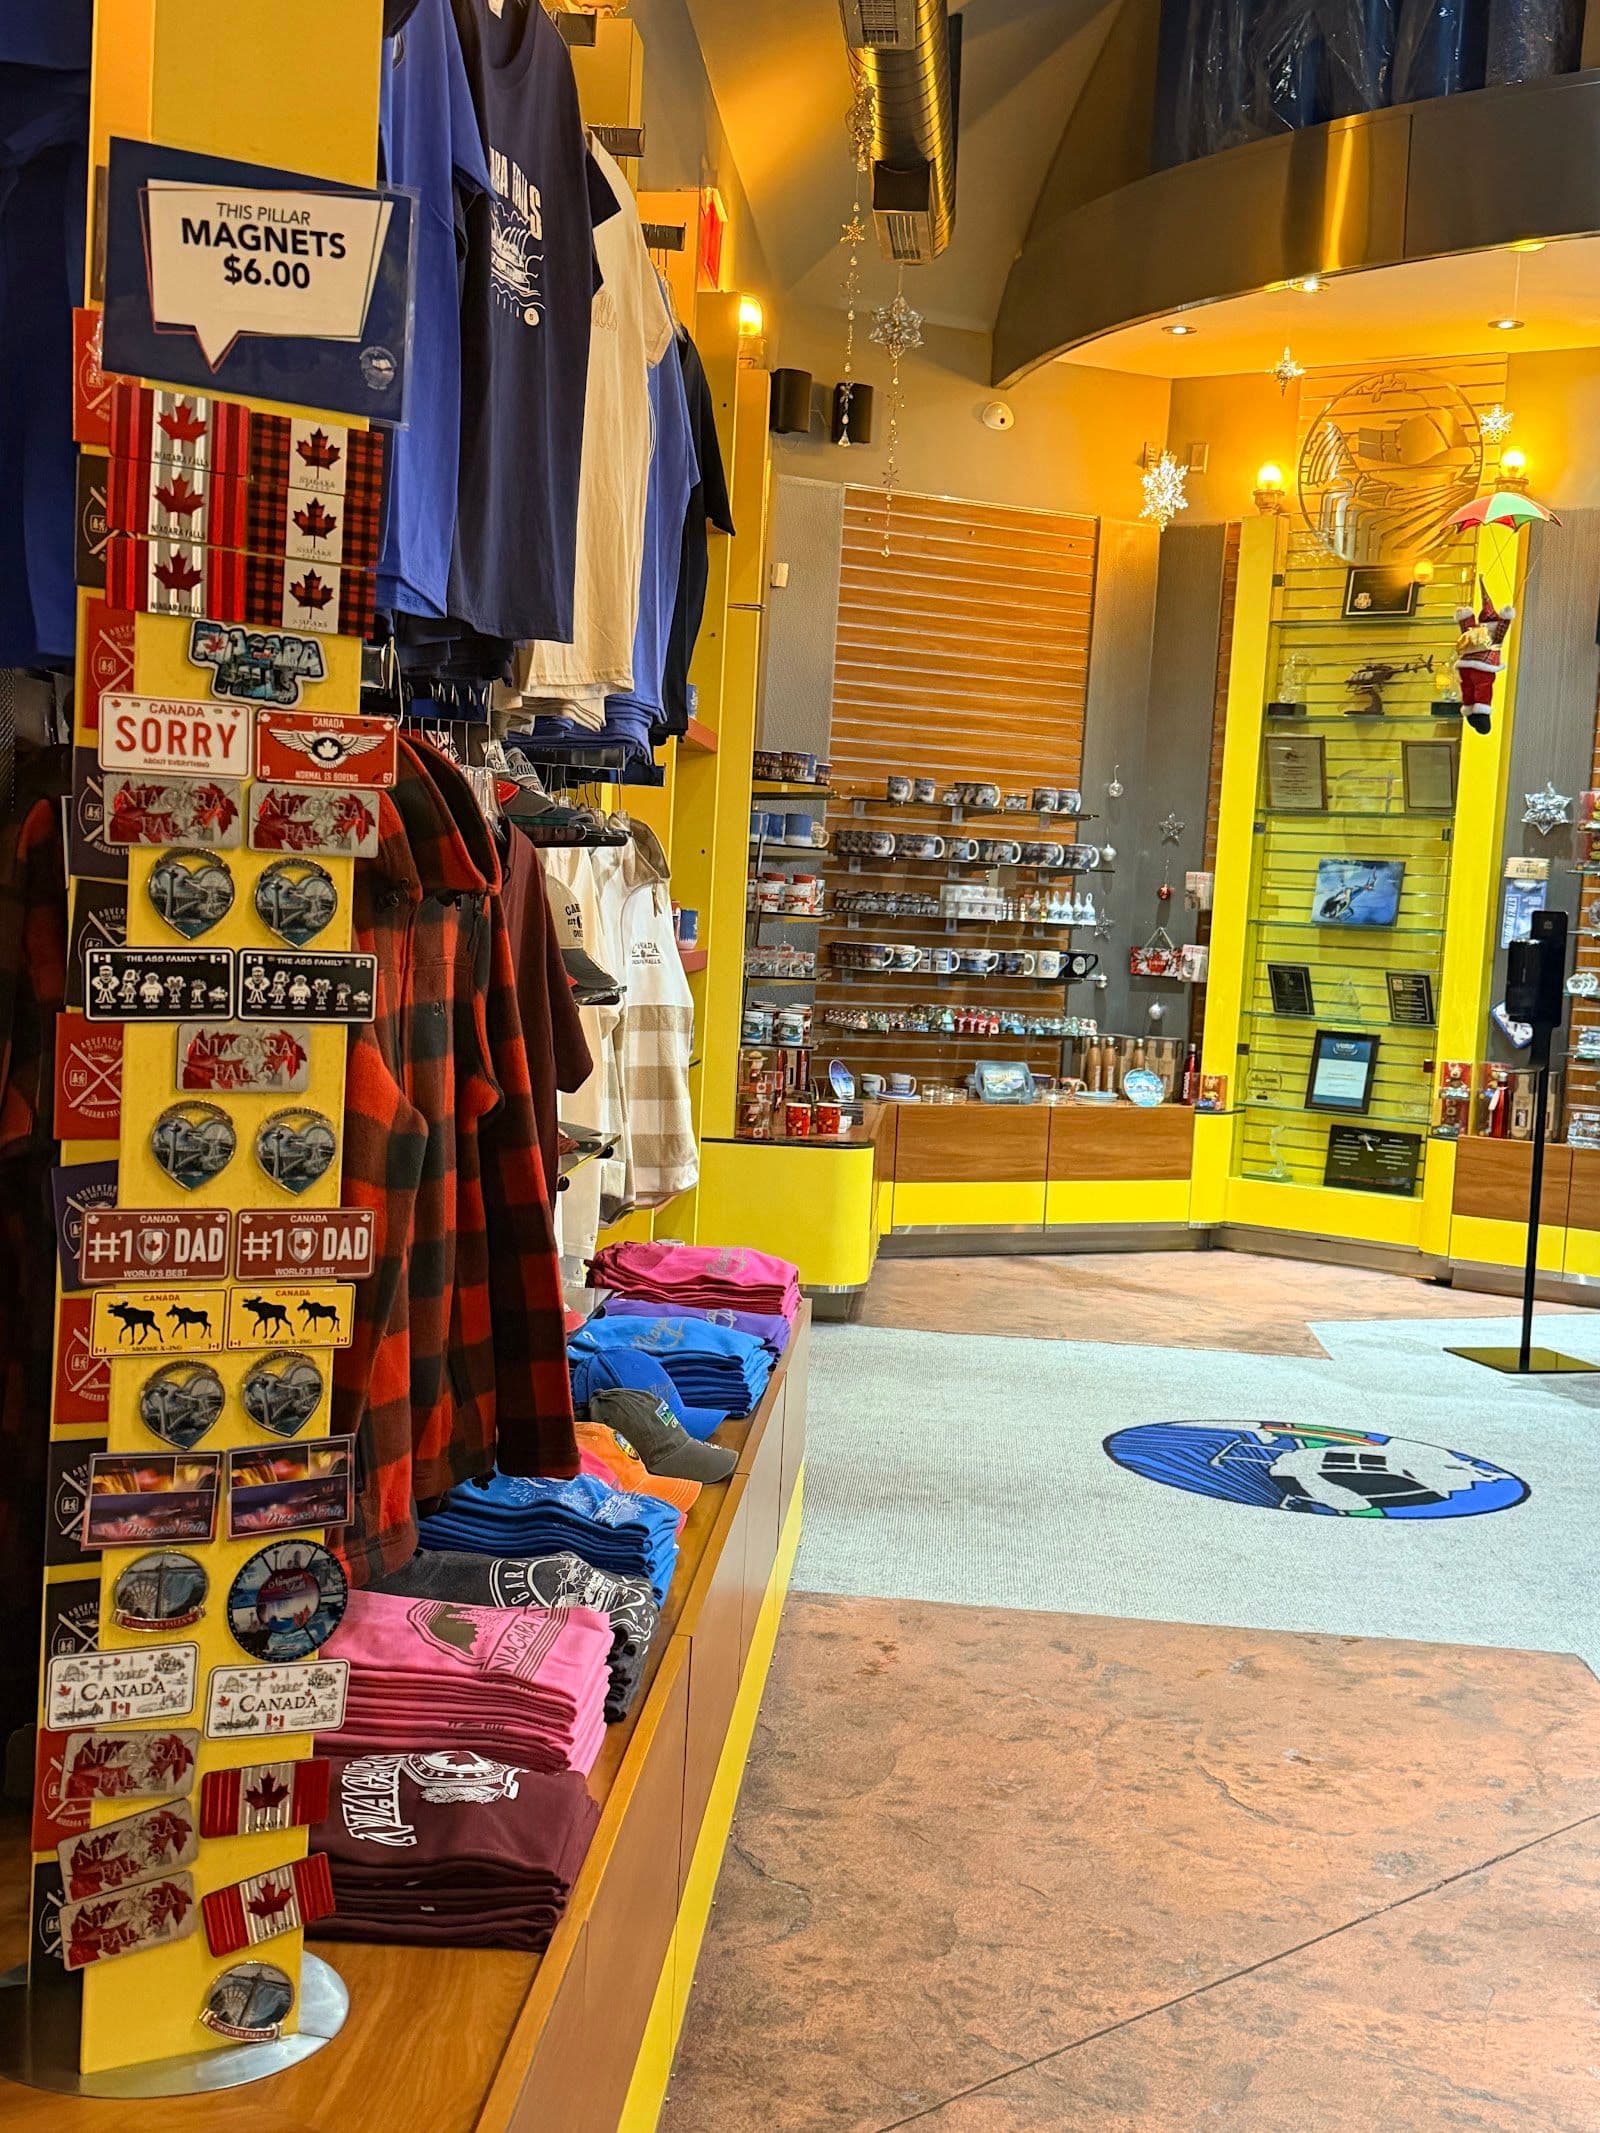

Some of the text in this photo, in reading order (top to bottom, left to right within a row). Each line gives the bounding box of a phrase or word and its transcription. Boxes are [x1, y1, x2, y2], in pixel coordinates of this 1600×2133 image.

[216, 202, 311, 226] THIS PILLAR
[181, 217, 346, 259] MAGNETS
[223, 253, 310, 289] $6.00
[149, 702, 206, 718] CANADA
[313, 717, 345, 729] CANADA
[115, 715, 237, 759] SORRY
[143, 758, 210, 768] ABOUT EVERYTHING
[295, 770, 359, 783] NORMAL IS BORING
[383, 772, 393, 783] 67
[126, 955, 198, 963] THE ASS FAMILY
[278, 957, 344, 967] THE ASS FAMILY
[195, 1039, 293, 1058] NIAGARA
[140, 1214, 180, 1224] CANADA
[290, 1214, 328, 1224] CANADA
[88, 1227, 224, 1264] #1 DAD
[242, 1226, 369, 1262] #1 DAD
[123, 1268, 188, 1278] WORLD'S BEST
[275, 1266, 336, 1276] WORLD'S BEST
[143, 1294, 180, 1302] CANADA
[275, 1289, 311, 1297] CANADA
[488, 1621, 538, 1673] NIAGARA
[80, 1679, 167, 1701] CANADA
[239, 1694, 318, 1713] CANADA
[98, 1768, 160, 1789] FALS
[101, 1847, 162, 1880] FALS
